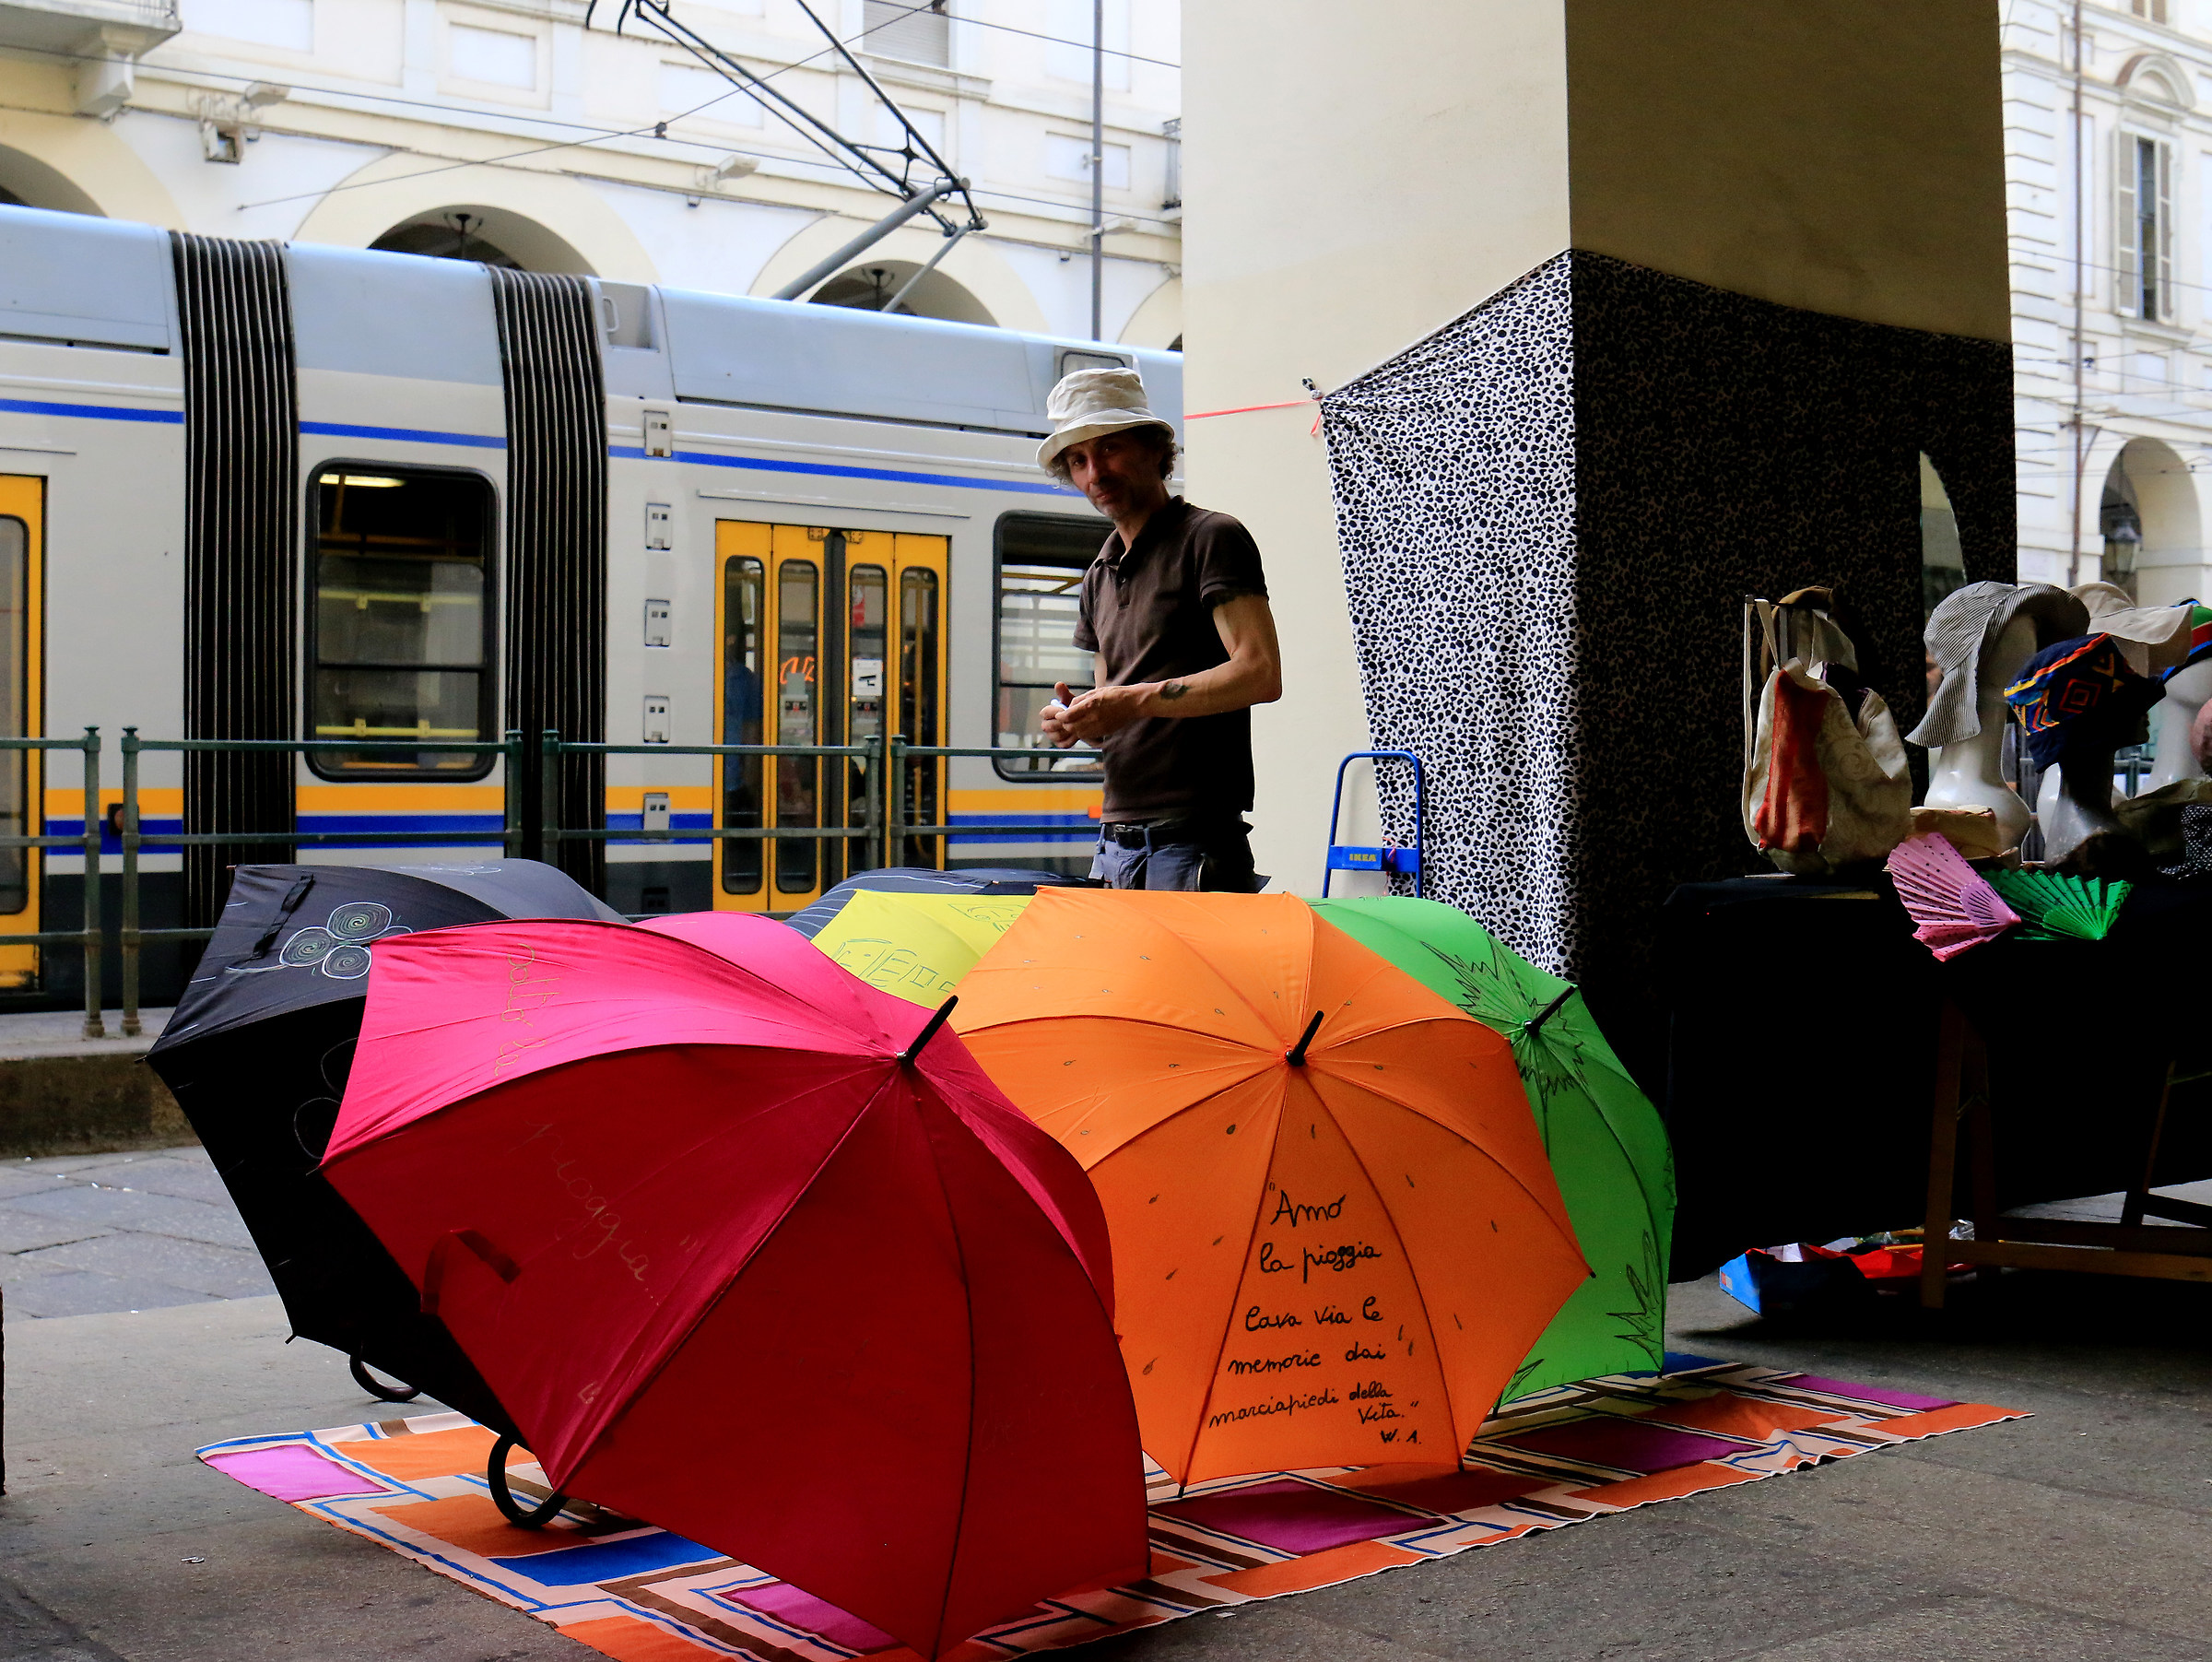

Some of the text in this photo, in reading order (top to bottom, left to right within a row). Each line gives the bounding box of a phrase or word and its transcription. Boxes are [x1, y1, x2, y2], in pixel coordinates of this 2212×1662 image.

[1348, 854, 1377, 862] IKEA
[1259, 1241, 1382, 1284] la pioggia
[1227, 1341, 1386, 1375] memorie dai
[1208, 1381, 1394, 1429] marciapiedi della
